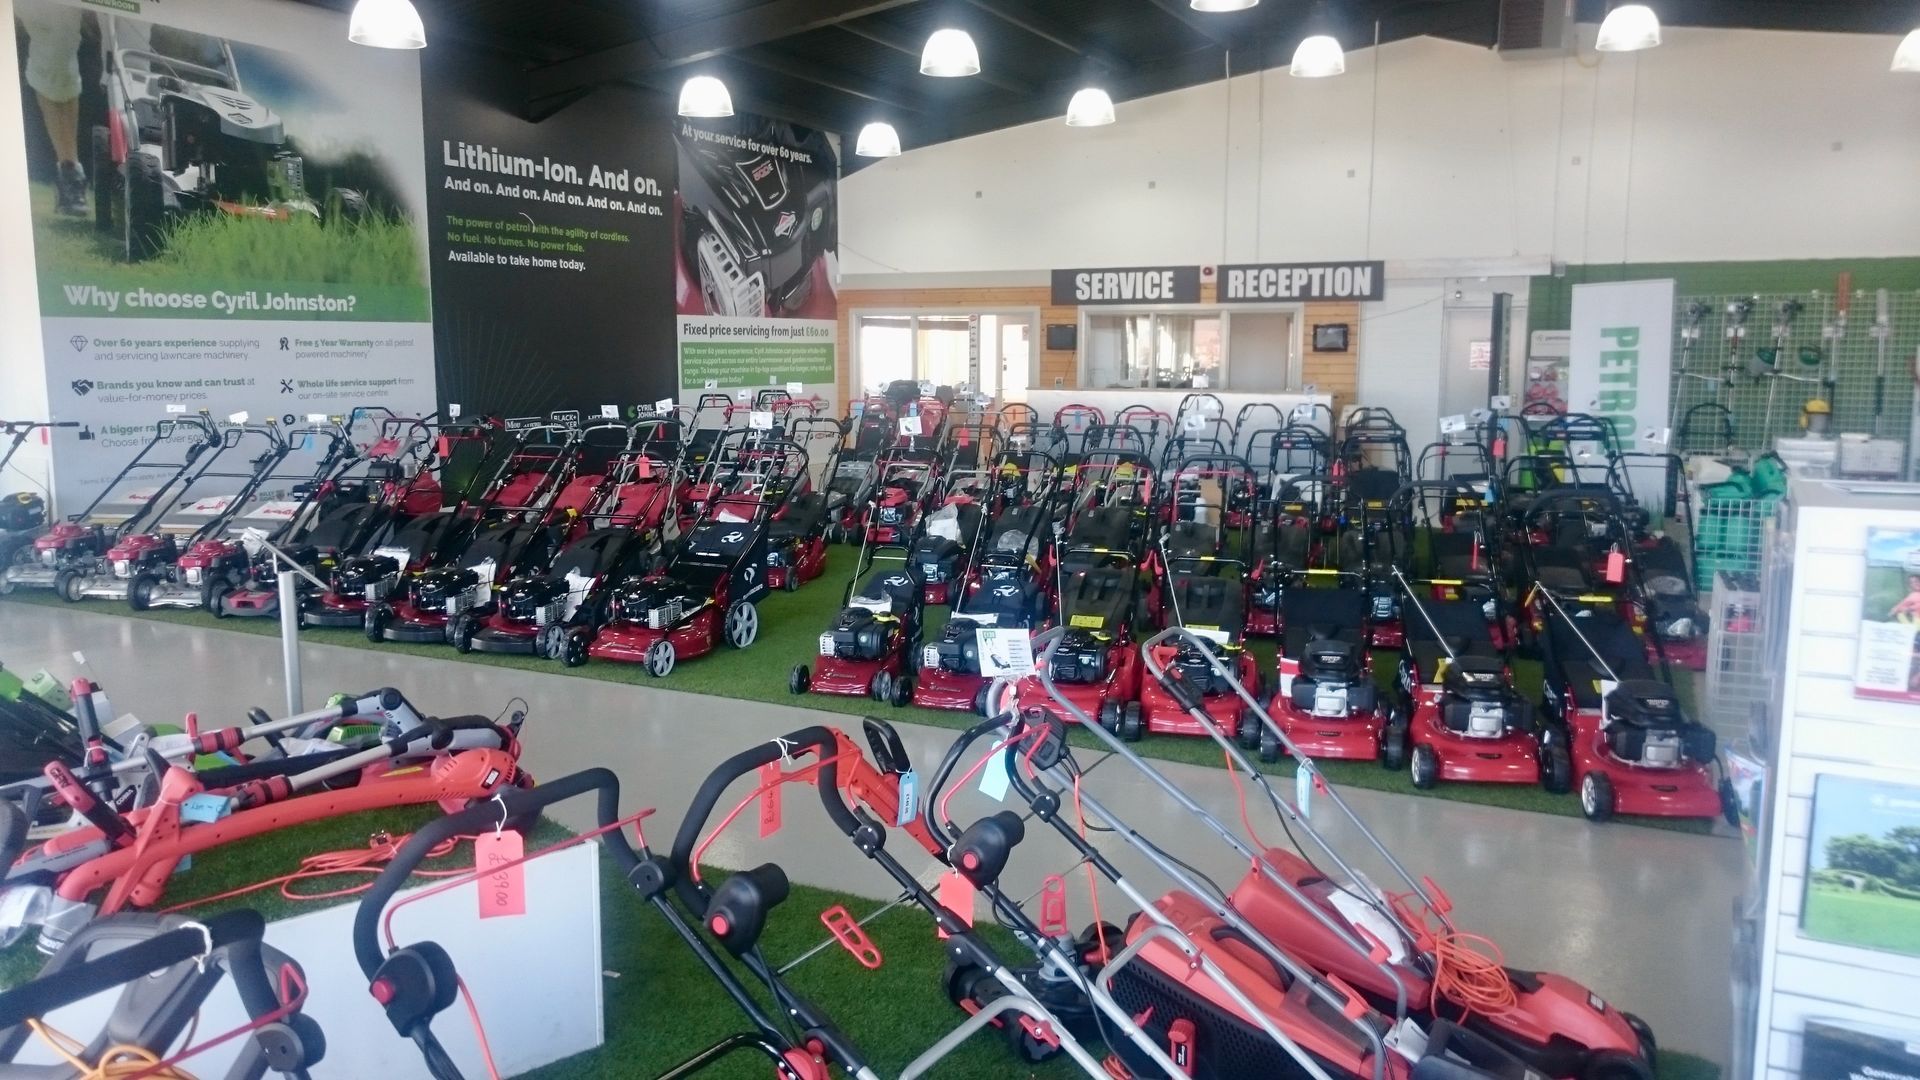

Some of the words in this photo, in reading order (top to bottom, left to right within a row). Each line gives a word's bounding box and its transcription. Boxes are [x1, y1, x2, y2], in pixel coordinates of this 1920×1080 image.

[683, 124, 692, 137] At
[693, 128, 714, 142] your
[715, 133, 746, 149] service
[748, 139, 760, 151] for
[761, 144, 779, 156] over
[780, 146, 789, 158] 60
[790, 149, 812, 163] years.
[444, 140, 583, 185] Lithium-Ion.
[589, 164, 628, 191] And
[634, 177, 661, 196] on.
[445, 176, 471, 191] And
[474, 182, 493, 194] on.
[496, 183, 519, 197] And
[523, 188, 540, 200] on.
[543, 189, 565, 203] And
[568, 194, 584, 206] on.
[587, 195, 607, 208] And
[610, 200, 625, 211] on.
[627, 201, 646, 213] And
[649, 206, 662, 216] on.
[446, 215, 463, 226] The
[466, 219, 492, 229] power
[495, 221, 503, 229] of
[506, 222, 530, 232] petrol
[551, 226, 563, 236] the
[566, 228, 589, 239] agility
[591, 230, 598, 239] of
[600, 232, 630, 242] cordless.
[447, 232, 460, 242] No
[463, 233, 481, 243] fuel.
[484, 235, 496, 245] No
[499, 237, 525, 247] fumes.
[528, 239, 538, 248] No
[541, 241, 564, 250] power
[566, 242, 584, 252] fade.
[449, 250, 494, 264] Available
[497, 253, 507, 265] to
[510, 254, 529, 266] take
[532, 256, 557, 268] home
[560, 258, 586, 272] today.
[1075, 271, 1174, 300] SERVICE
[1227, 266, 1372, 298] RECEPTION
[63, 285, 120, 312] Why
[125, 287, 207, 308] choose
[211, 290, 260, 314] Cyril
[262, 292, 356, 312] Johnston?
[684, 323, 707, 335] Fixed
[709, 324, 731, 338] price
[733, 325, 769, 338] servicing
[771, 326, 789, 337] from
[790, 327, 804, 339] just
[93, 338, 117, 347] Over
[120, 338, 132, 347] 60
[135, 339, 162, 349] years
[164, 338, 217, 349] experience
[219, 338, 260, 349] supplying
[295, 339, 312, 347] Free
[320, 339, 337, 347] Year
[339, 339, 373, 348] Warranty
[95, 351, 113, 361] and
[116, 351, 158, 362] servicing
[161, 351, 201, 360] lawncare
[296, 350, 329, 360] powered
[97, 380, 134, 390] Brands
[136, 381, 154, 391] you
[156, 380, 182, 388] know
[184, 379, 202, 387] and
[205, 379, 221, 387] can
[223, 377, 245, 386] trust
[247, 378, 255, 386] at
[297, 380, 324, 388] Whole
[325, 379, 337, 387] life
[340, 379, 367, 387] service
[369, 378, 397, 387] support
[97, 391, 178, 403] value-for-money
[110, 424, 143, 436] bigger
